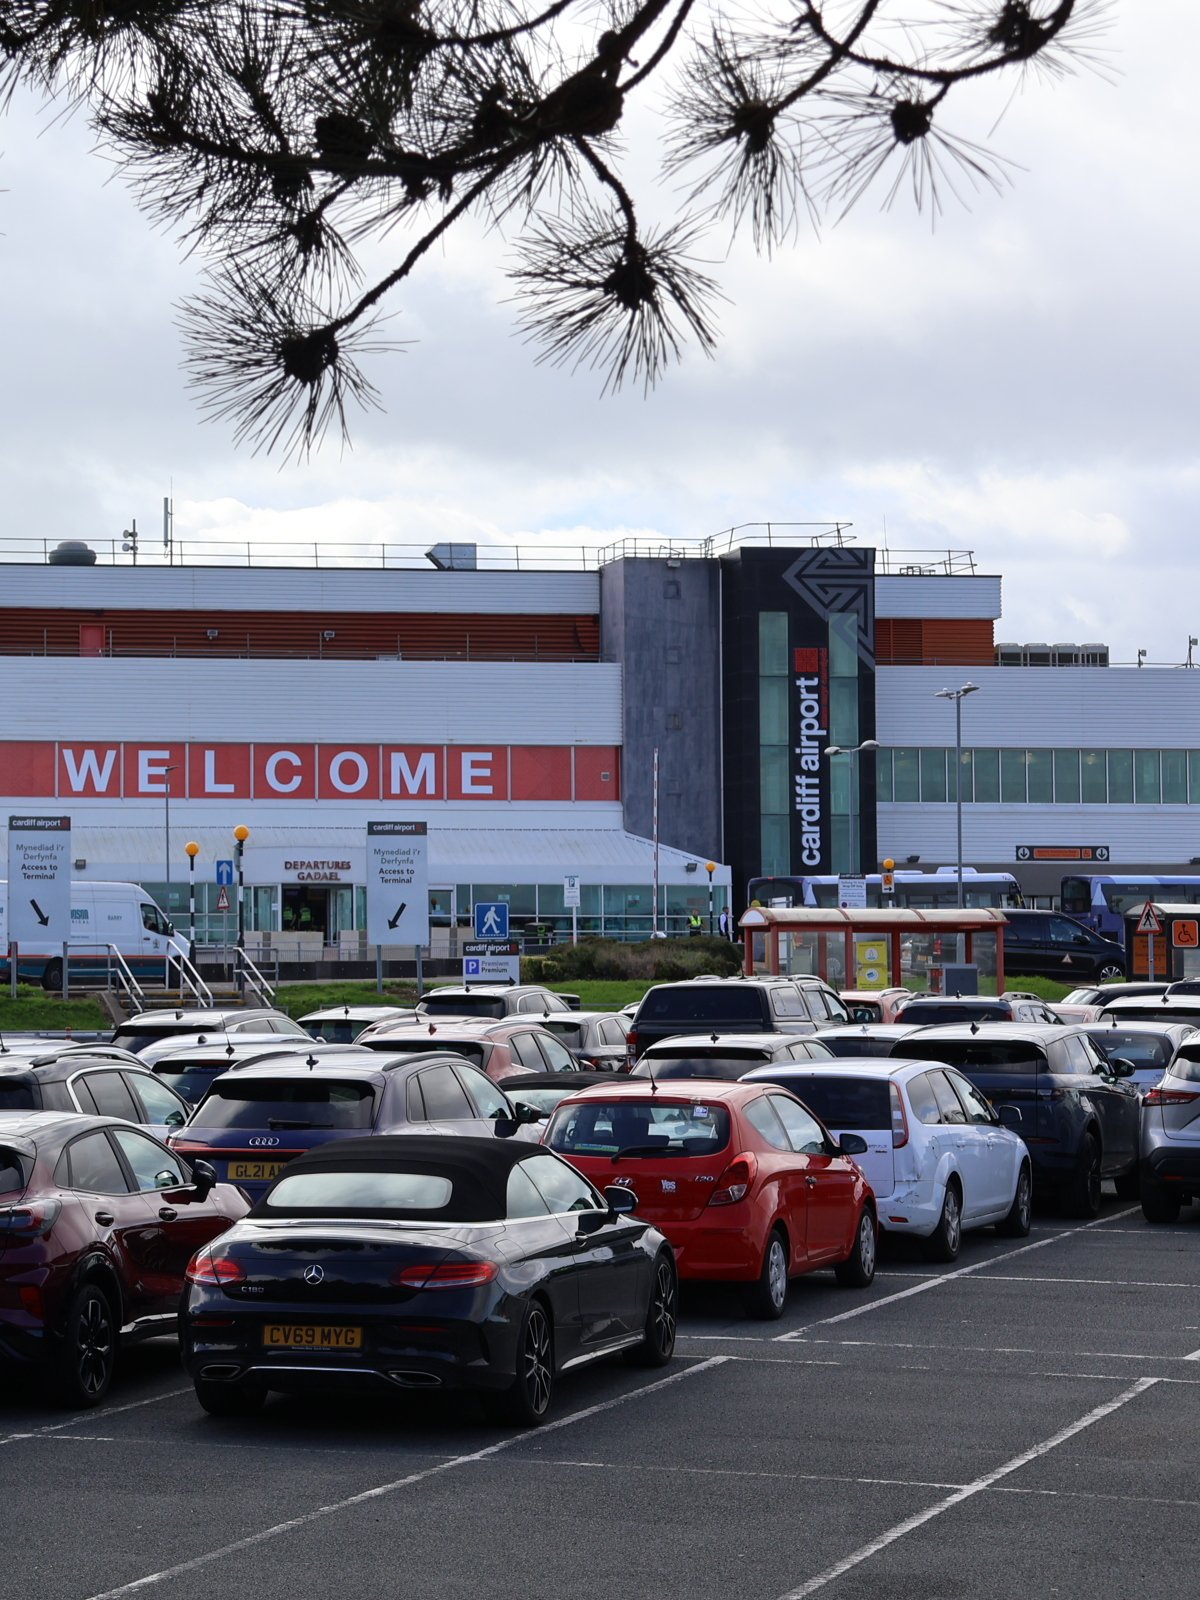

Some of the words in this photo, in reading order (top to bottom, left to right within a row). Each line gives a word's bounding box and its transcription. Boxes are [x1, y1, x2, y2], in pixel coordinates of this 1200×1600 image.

[795, 676, 827, 772] airport
[62, 748, 493, 795] WELCOME
[12, 818, 36, 826] cardiff
[36, 818, 61, 829] airport
[795, 775, 821, 866] cardiff
[394, 824, 416, 833] airport
[15, 843, 55, 853] Mynediad
[373, 848, 411, 857] Mynediad
[23, 852, 58, 862] Derfynfa
[380, 857, 414, 866] Derfynfa
[21, 863, 48, 871] Access
[284, 860, 352, 870] DEPARTURES
[22, 872, 56, 880] Terminal
[297, 871, 341, 881] GADAEL
[379, 867, 405, 875] Access
[380, 876, 413, 884] Terminal
[465, 943, 487, 952] cardiff
[487, 944, 510, 954] airport
[235, 1164, 265, 1178] GL21
[661, 1179, 676, 1190] Yes
[269, 1326, 316, 1345] CV69
[320, 1327, 356, 1346] MYG
